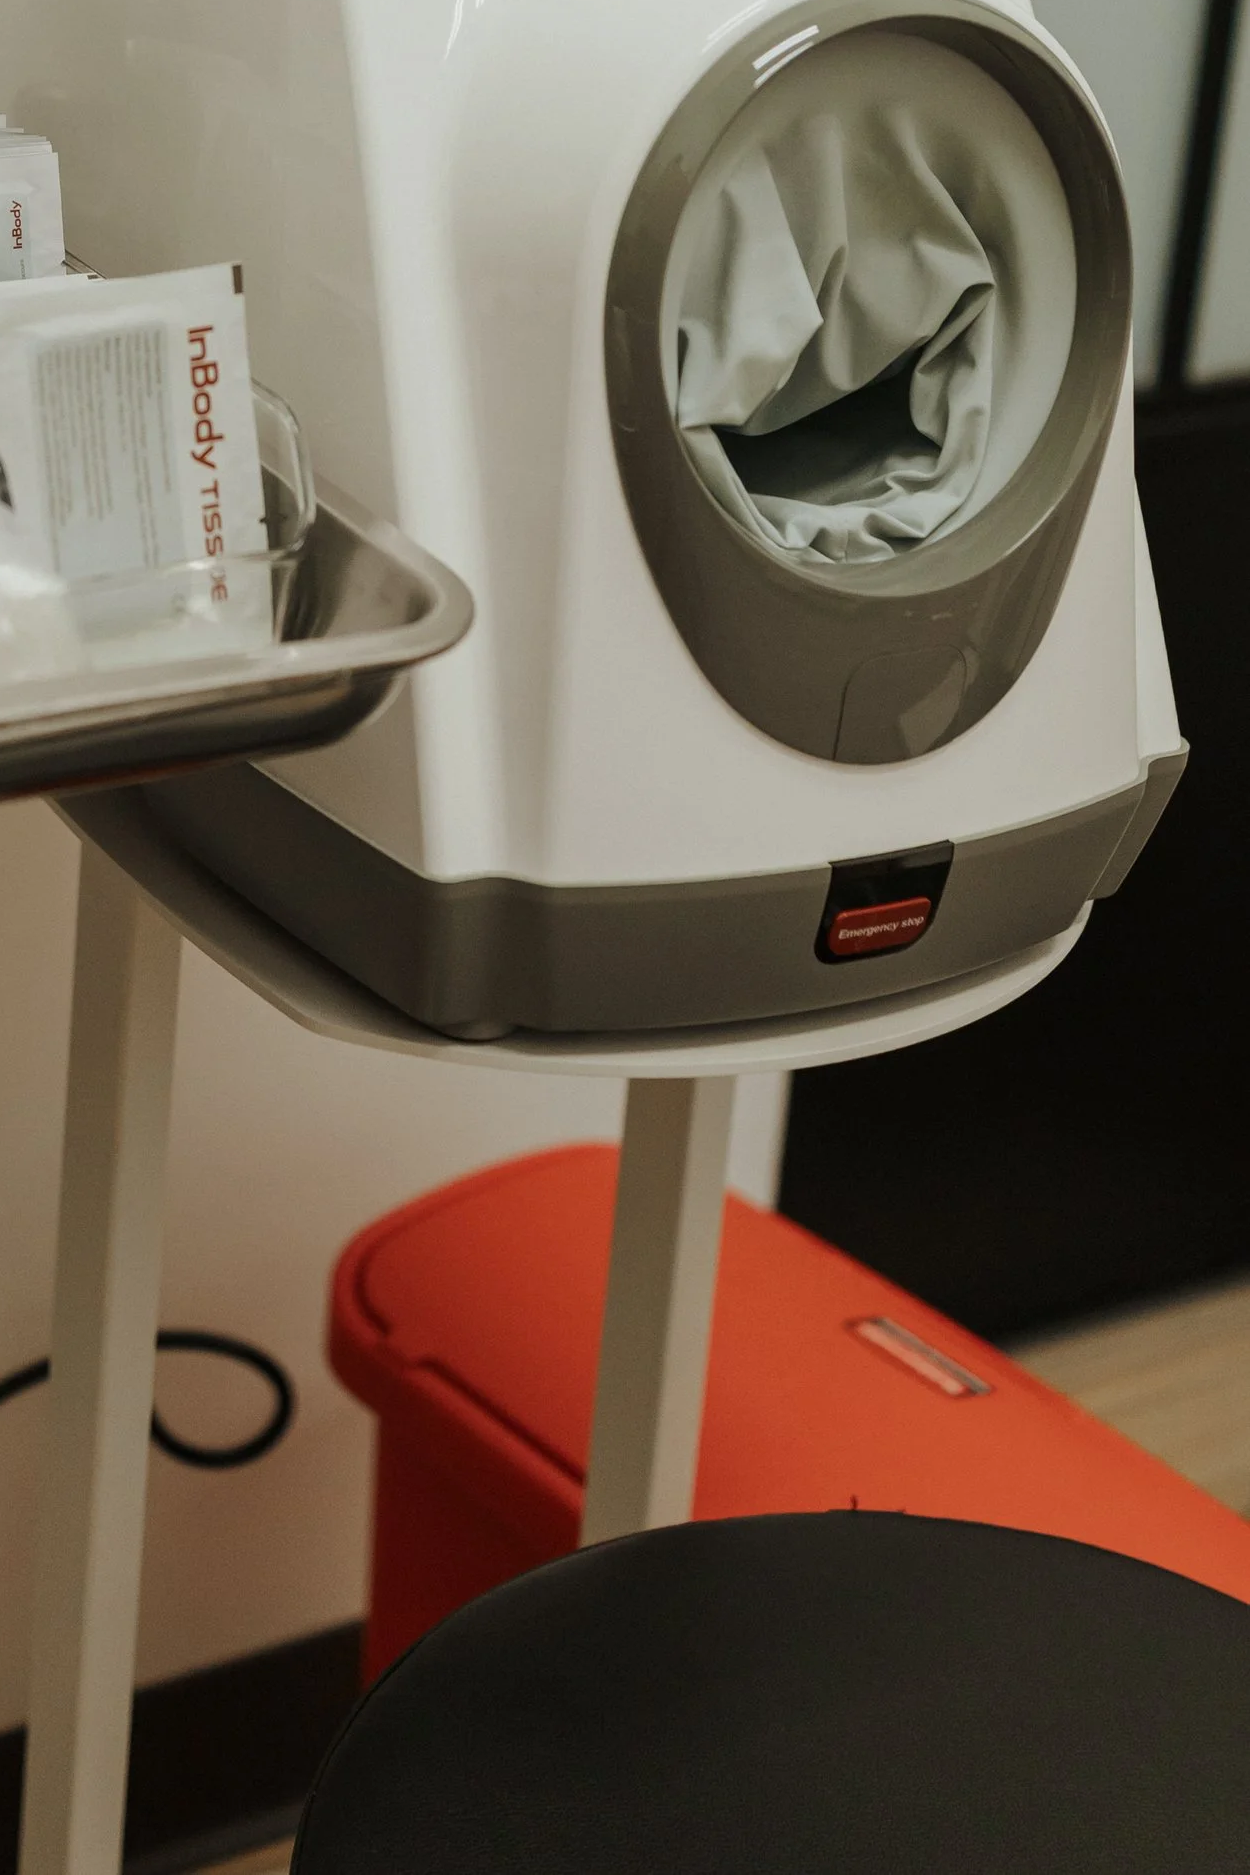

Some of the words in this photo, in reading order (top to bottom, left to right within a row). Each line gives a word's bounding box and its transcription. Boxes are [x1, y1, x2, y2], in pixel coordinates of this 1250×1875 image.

[9, 200, 23, 250] InBody
[187, 325, 225, 471] InBody
[838, 922, 899, 940] Emergency
[901, 915, 926, 928] stop
